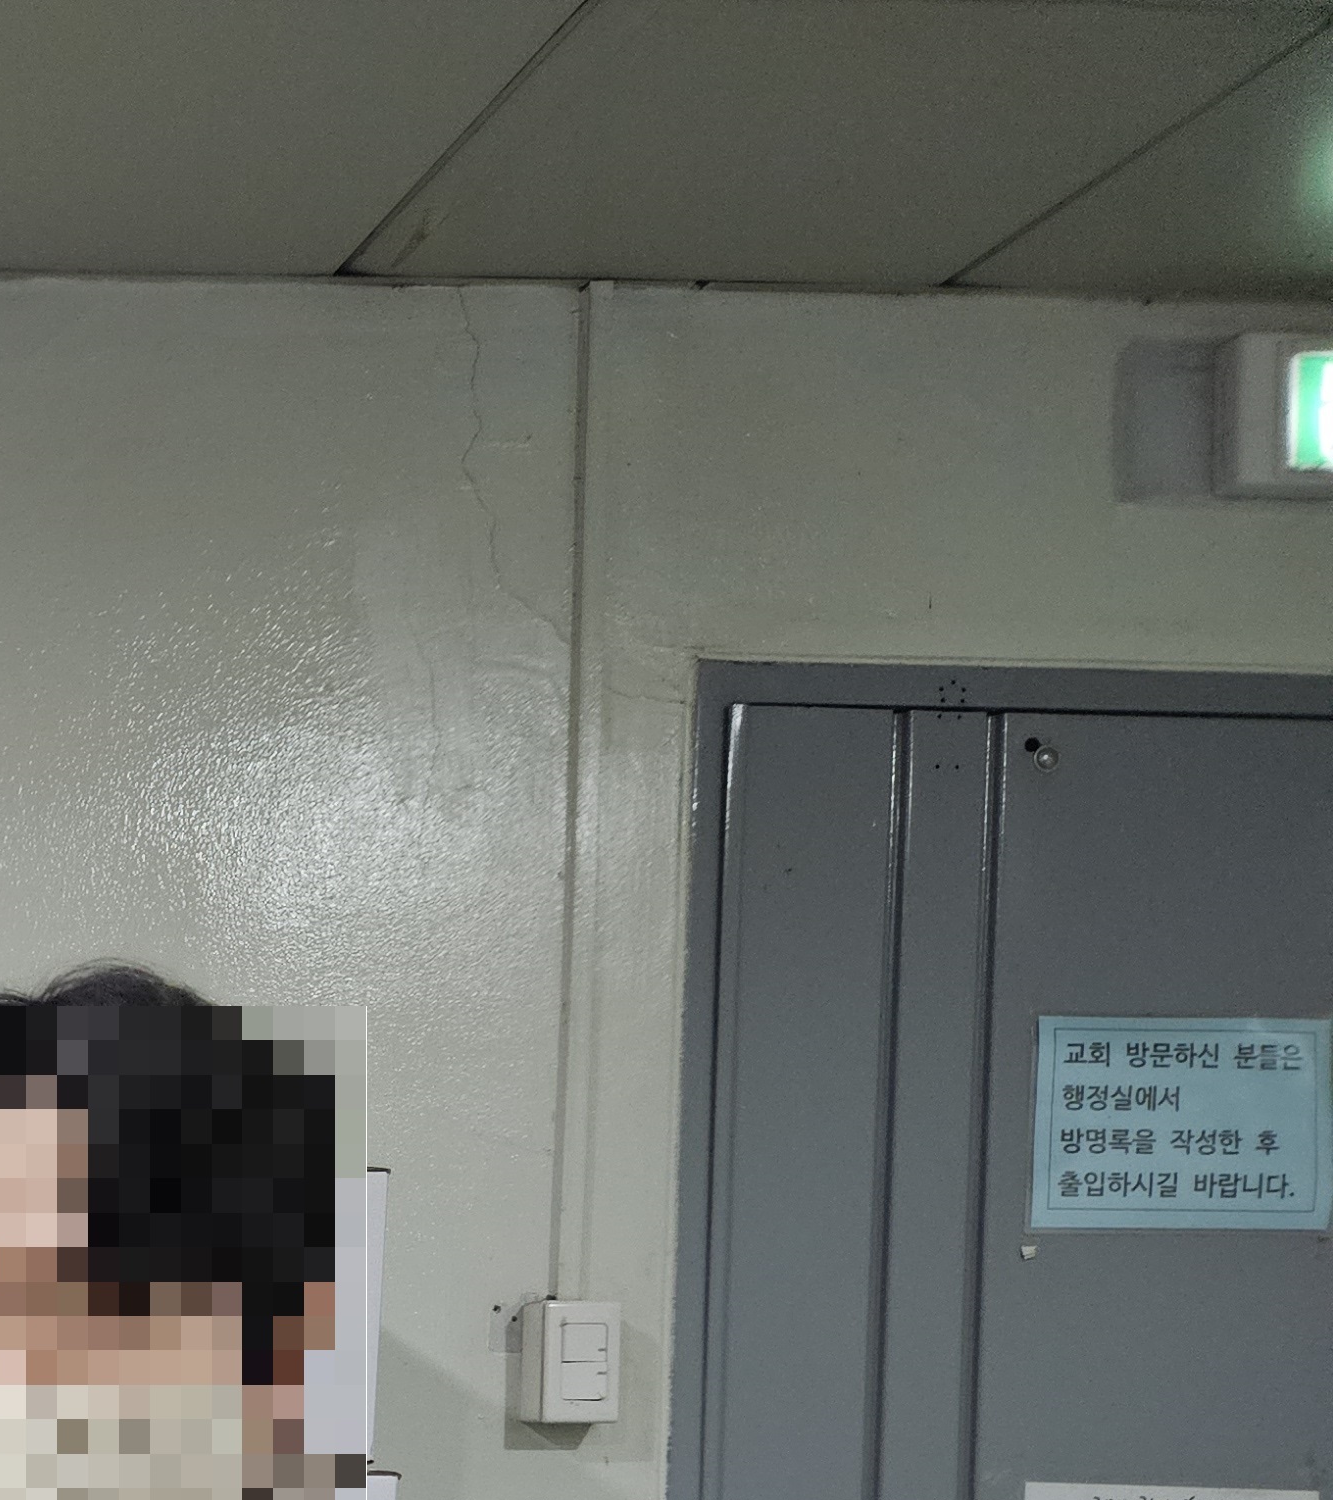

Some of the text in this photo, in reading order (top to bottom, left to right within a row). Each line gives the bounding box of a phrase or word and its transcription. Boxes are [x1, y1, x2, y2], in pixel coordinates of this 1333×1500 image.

[1063, 1041, 1303, 1071] 교회 방문하신 분들은
[1062, 1085, 1180, 1112] 행정실에서
[1060, 1128, 1280, 1156] 방명록을 작성한 후
[1058, 1171, 1295, 1199] 출입하시길 바랍니다.
